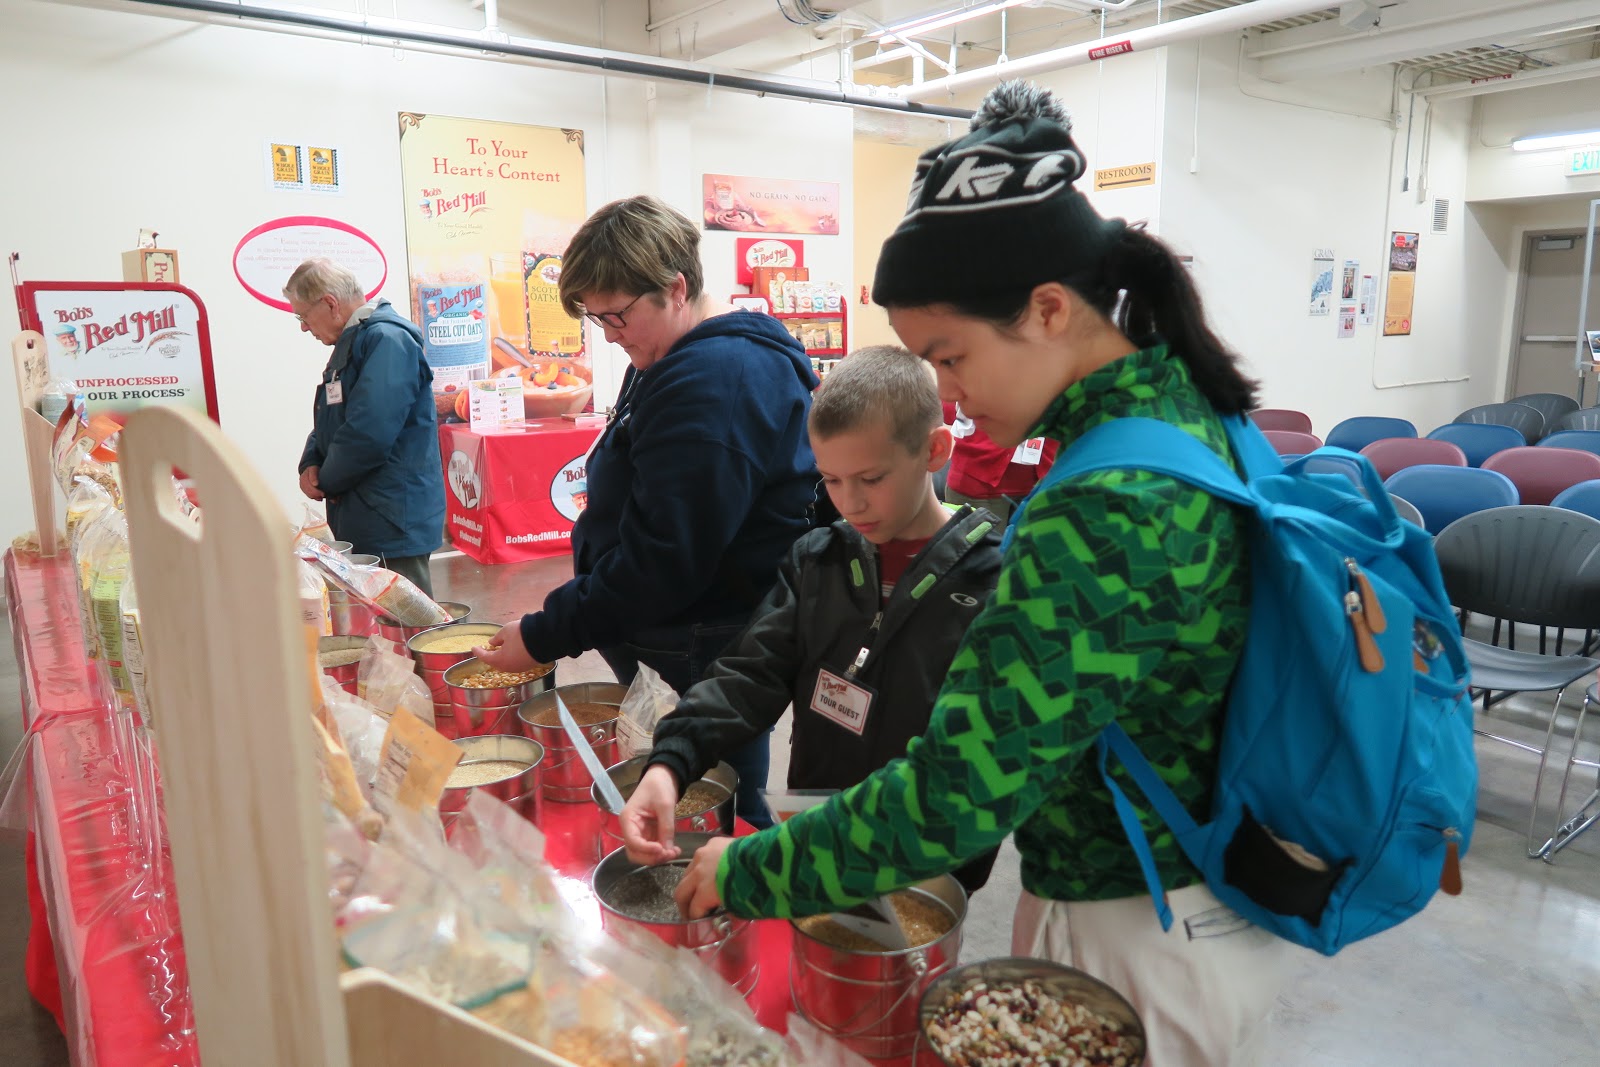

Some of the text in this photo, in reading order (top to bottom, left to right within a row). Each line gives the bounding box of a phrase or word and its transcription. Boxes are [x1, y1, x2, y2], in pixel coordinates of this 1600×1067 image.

[1092, 43, 1128, 58] FIRE RISER 1
[466, 138, 528, 159] To Your
[432, 157, 561, 183] Heart's Content
[1097, 165, 1152, 180] RESTROOMS
[421, 188, 442, 198] Bob's
[436, 190, 487, 218] Red Mill
[760, 248, 788, 265] Red Mill
[530, 292, 558, 303] OATM
[531, 286, 558, 294] SCOTT
[439, 283, 484, 314] Red Mill
[54, 307, 94, 323] Bob's
[81, 304, 178, 355] Red Mill
[429, 322, 482, 338] STEEL CUT OATS
[75, 376, 179, 388] UNPROCESSED
[88, 391, 118, 401] OUR
[562, 466, 587, 483] Bob
[506, 530, 571, 544] BobsRedMill.co
[820, 694, 860, 720] TOUR GUEST
